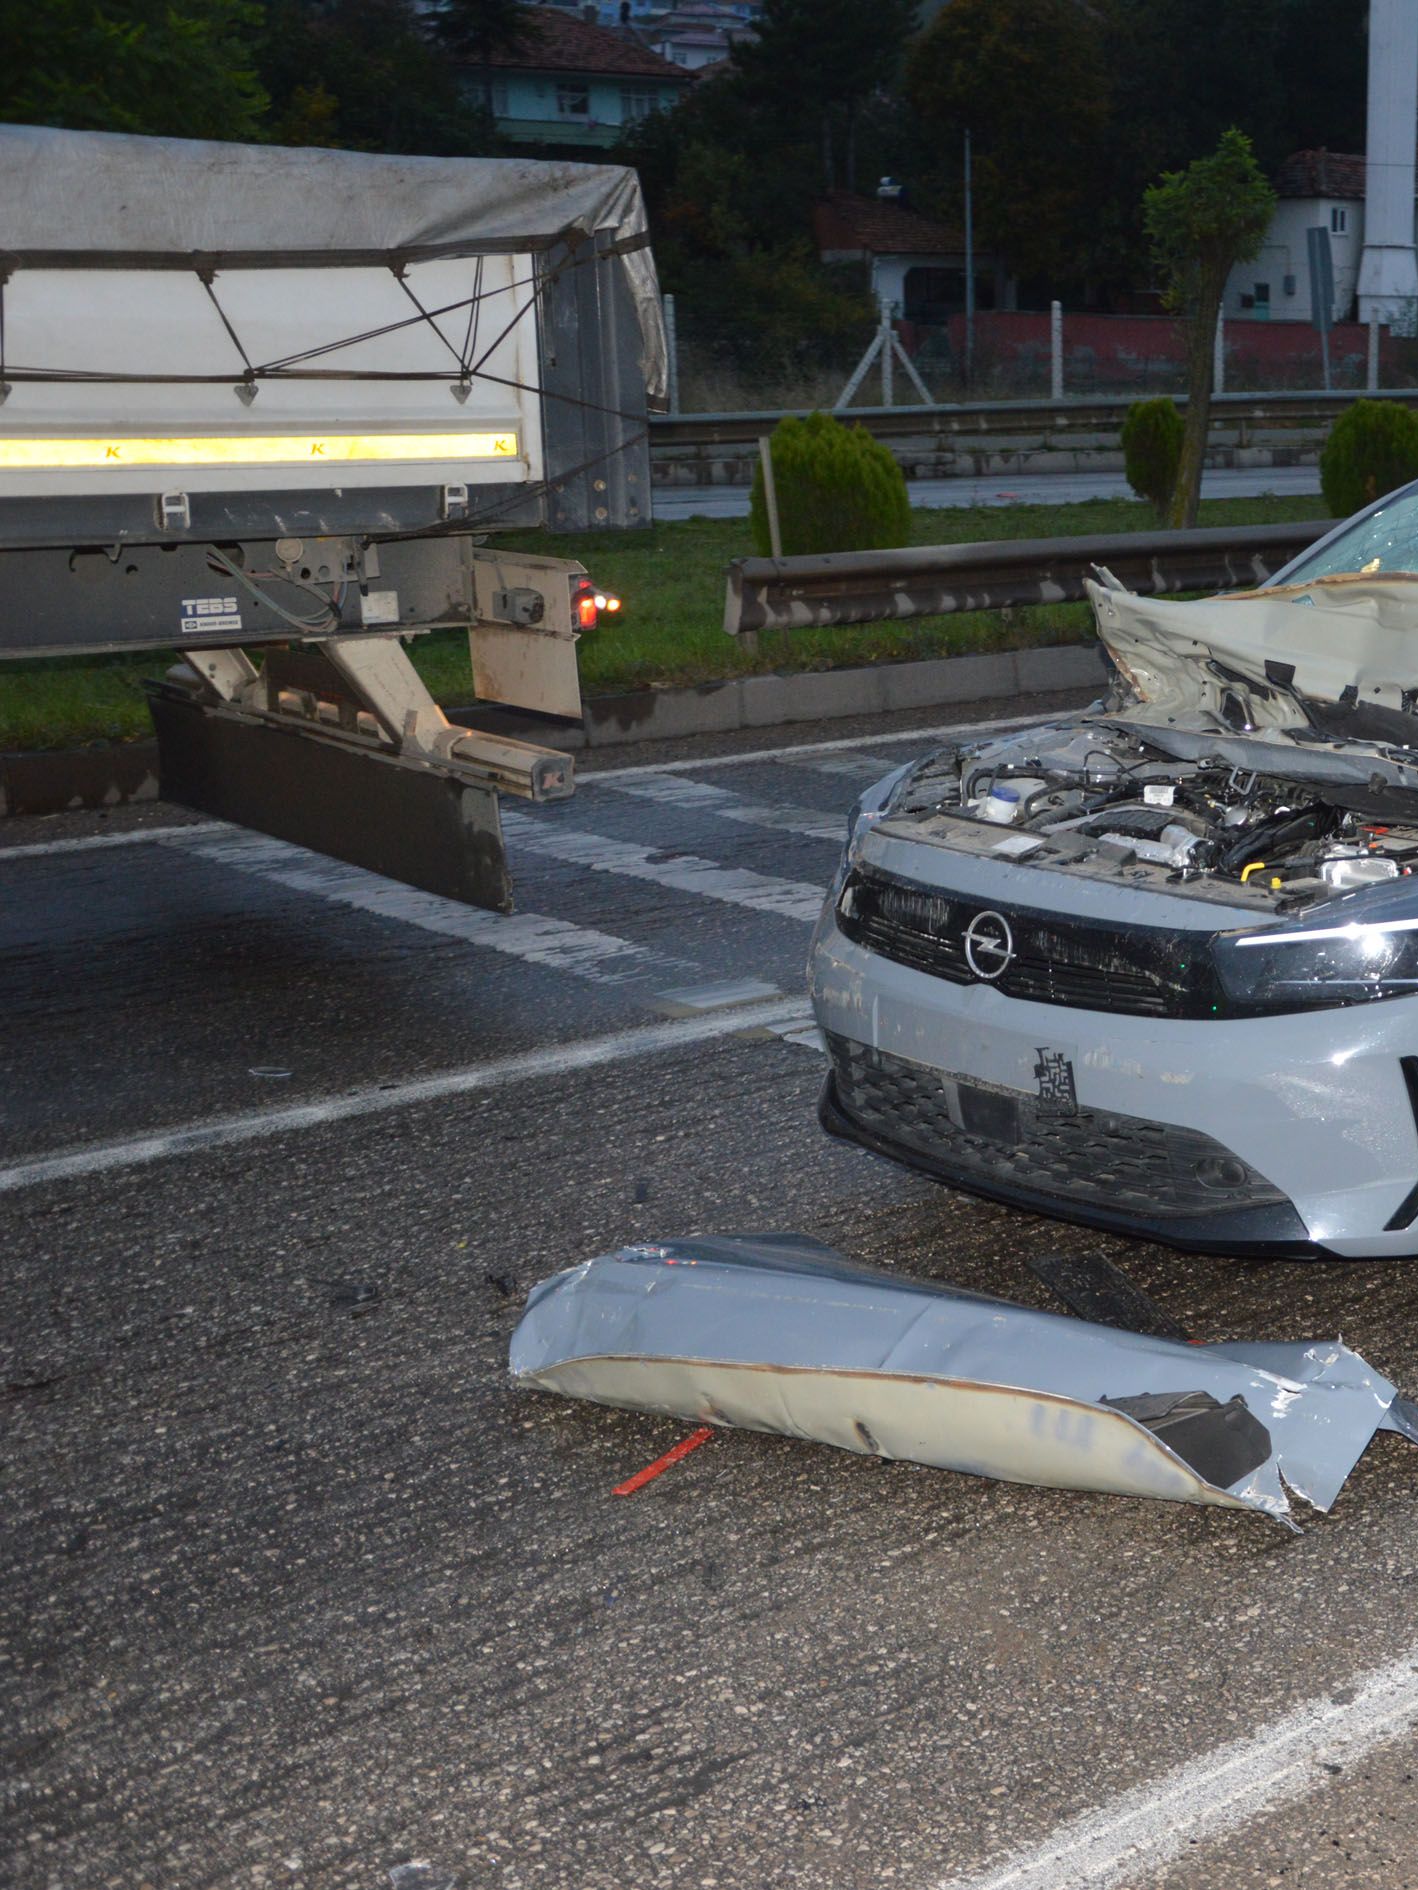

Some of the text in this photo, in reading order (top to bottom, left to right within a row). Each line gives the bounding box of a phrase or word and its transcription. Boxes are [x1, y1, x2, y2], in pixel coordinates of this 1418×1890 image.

[105, 446, 120, 458] K
[311, 443, 325, 454] K
[182, 597, 238, 615] TEBS
